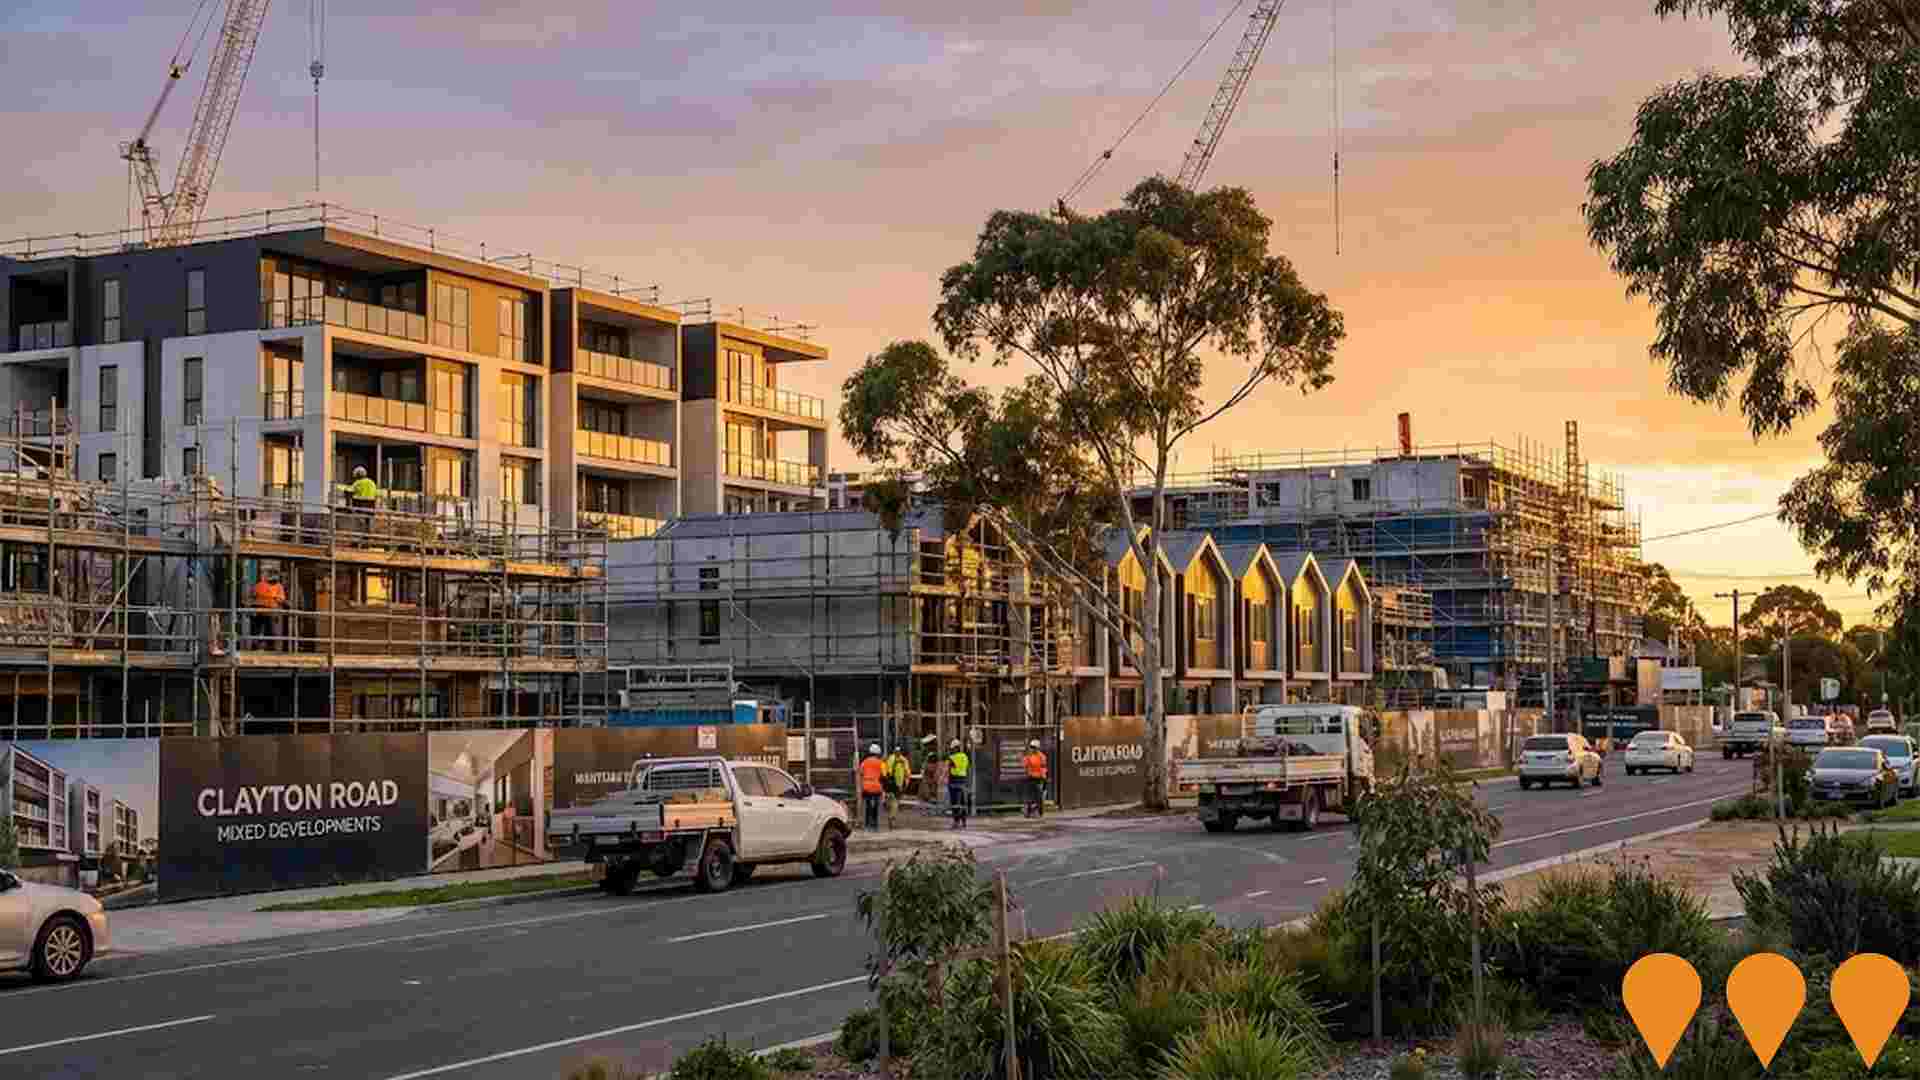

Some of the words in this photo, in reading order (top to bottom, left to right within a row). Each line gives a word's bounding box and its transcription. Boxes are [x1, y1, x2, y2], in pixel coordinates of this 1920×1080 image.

[197, 784, 323, 816] CLAYTON
[329, 780, 399, 809] ROAD
[217, 824, 265, 842] MIXED
[269, 815, 381, 839] DEVELOPMENTS
